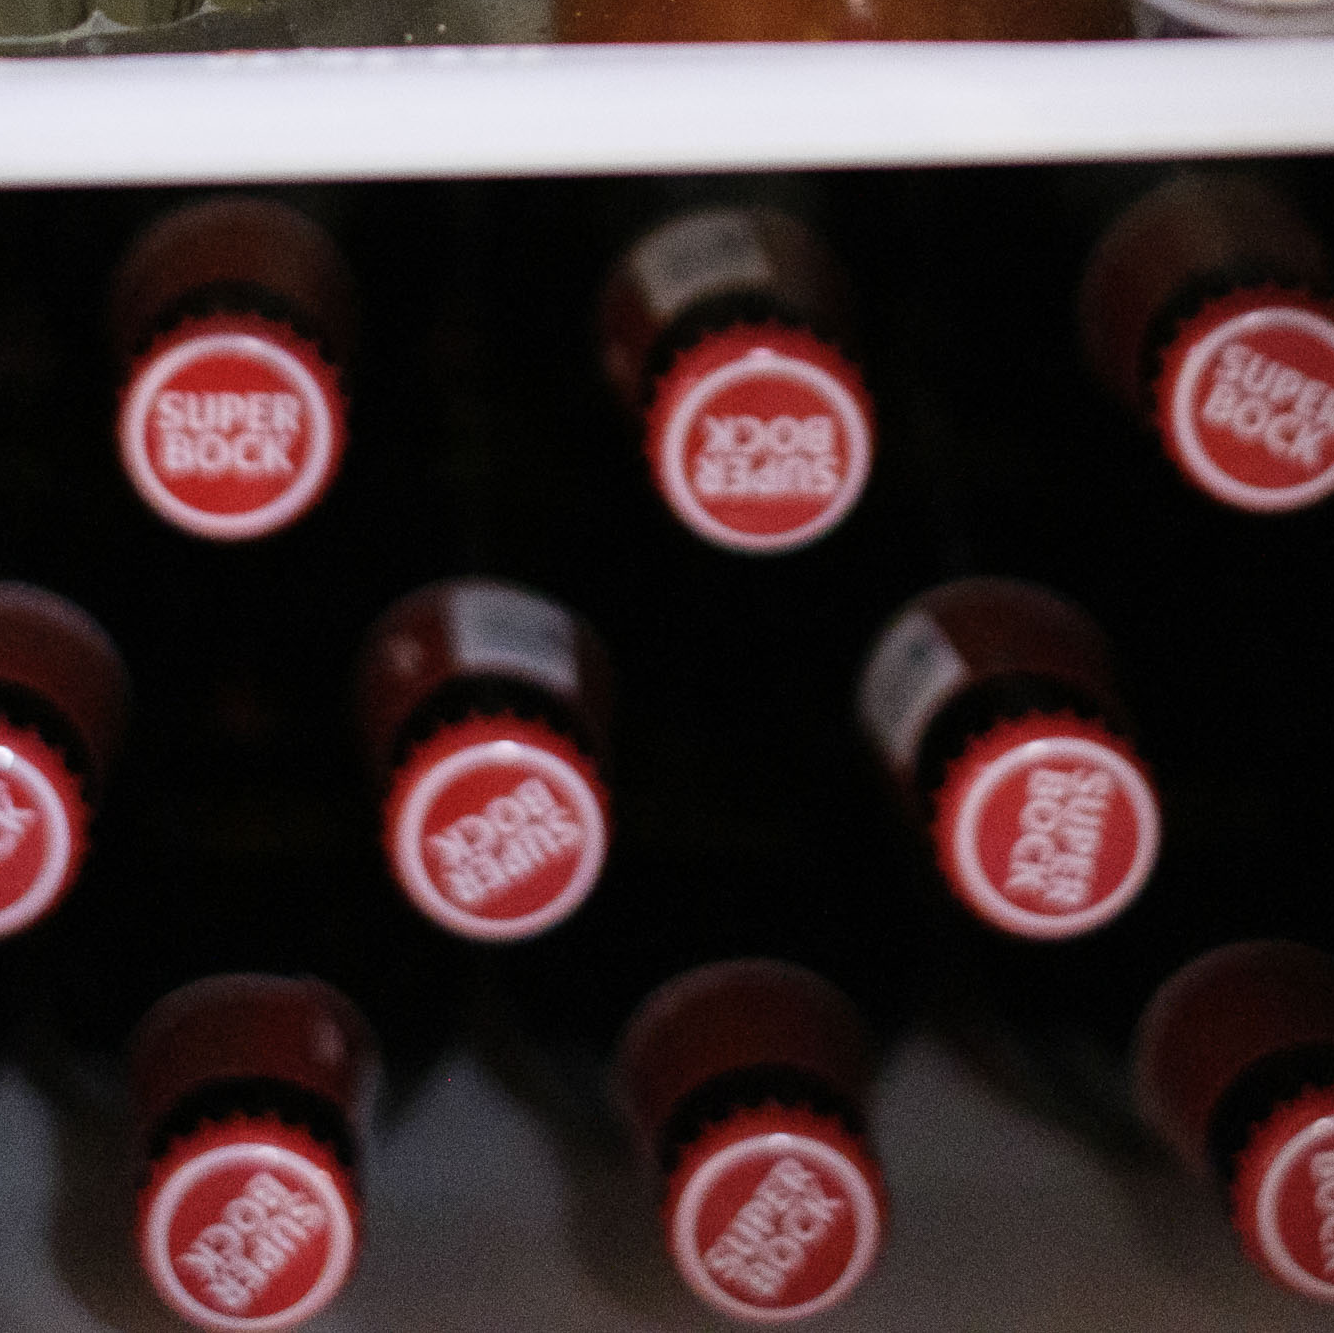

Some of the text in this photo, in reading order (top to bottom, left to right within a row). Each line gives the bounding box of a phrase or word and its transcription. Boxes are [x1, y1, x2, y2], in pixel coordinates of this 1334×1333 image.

[153, 390, 303, 435] SUPER
[159, 431, 293, 477] BOCK
[702, 416, 835, 454] BOCK
[693, 454, 838, 499] SUPER
[429, 773, 559, 875] BOCK
[444, 806, 578, 905] SUPER
[1007, 767, 1071, 893] BOCK
[1041, 769, 1115, 907] SUPER
[183, 1166, 294, 1278] BOCK
[208, 1192, 327, 1309] SUPER
[704, 1156, 820, 1279] SUPER
[730, 1189, 842, 1296] BOCK
